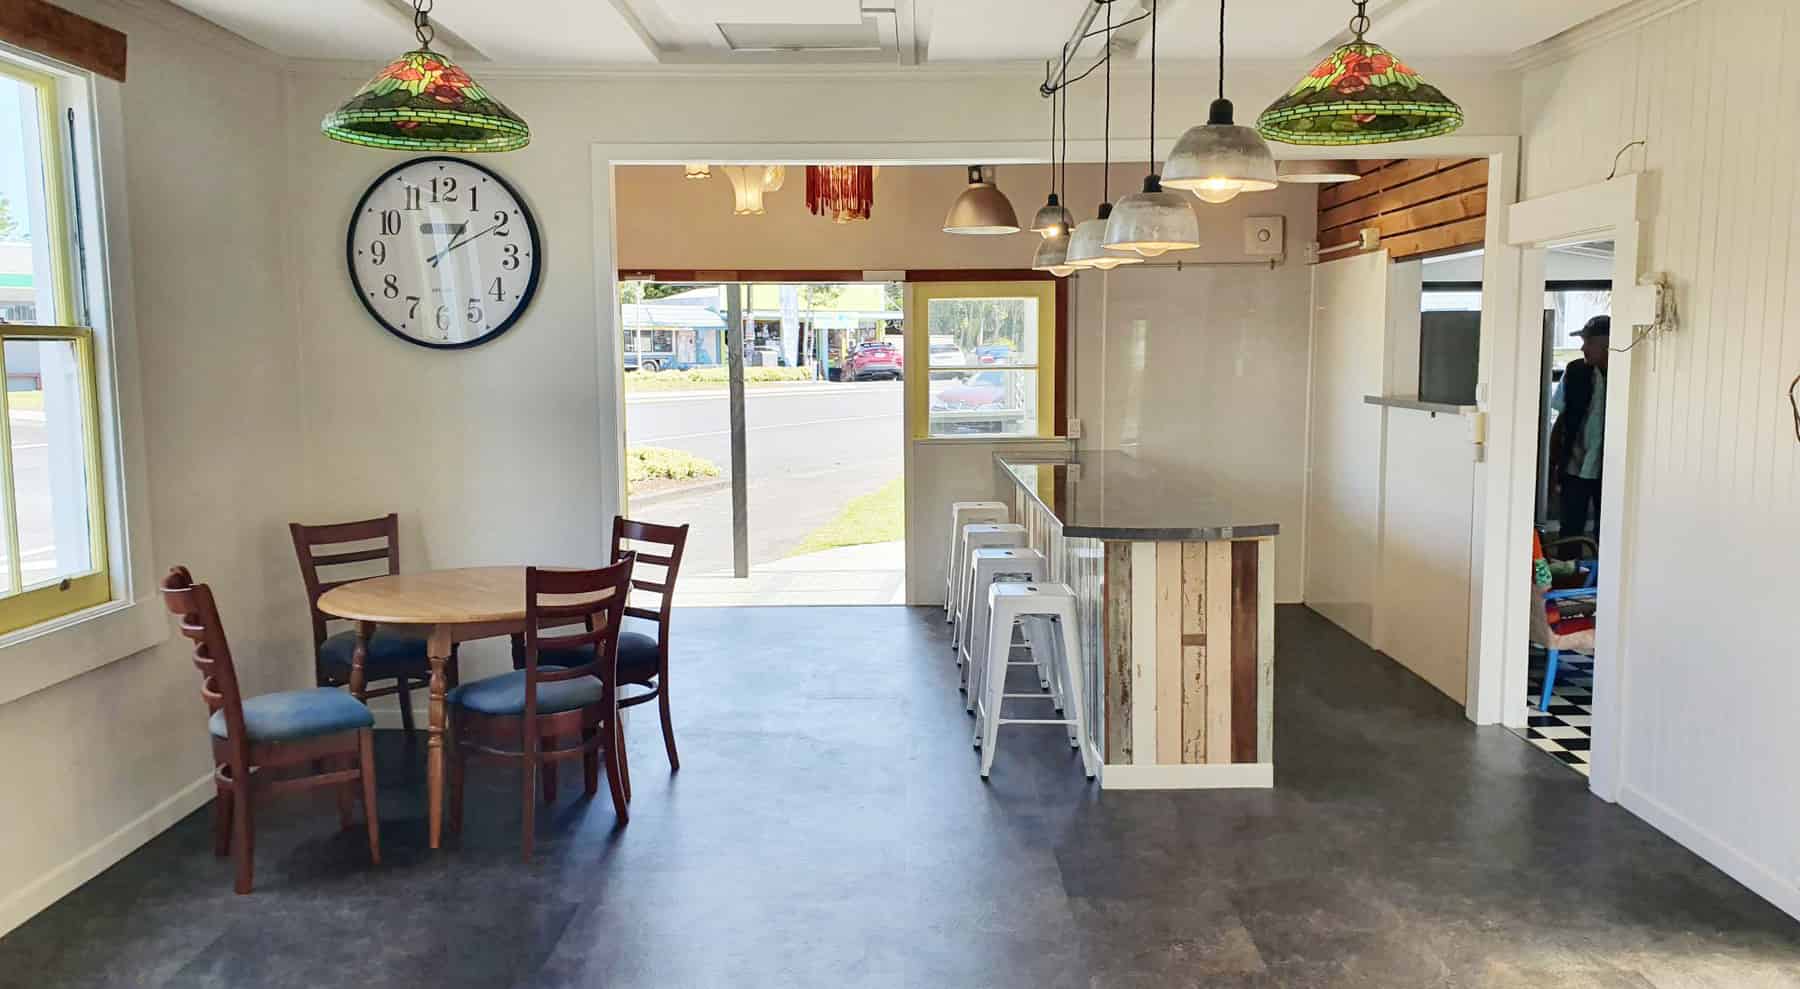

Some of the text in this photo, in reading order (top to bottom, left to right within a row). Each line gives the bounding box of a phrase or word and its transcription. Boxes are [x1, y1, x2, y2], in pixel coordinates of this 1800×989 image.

[404, 184, 423, 211] 11
[429, 177, 458, 203] 12
[469, 185, 480, 212] 1
[379, 209, 402, 235] 10
[493, 210, 510, 237] 2
[371, 240, 386, 265] 9
[502, 244, 520, 270] 3
[384, 274, 399, 299] 8
[488, 276, 506, 302] 4
[405, 296, 420, 319] 7
[436, 305, 450, 331] 6
[467, 298, 483, 323] 5
